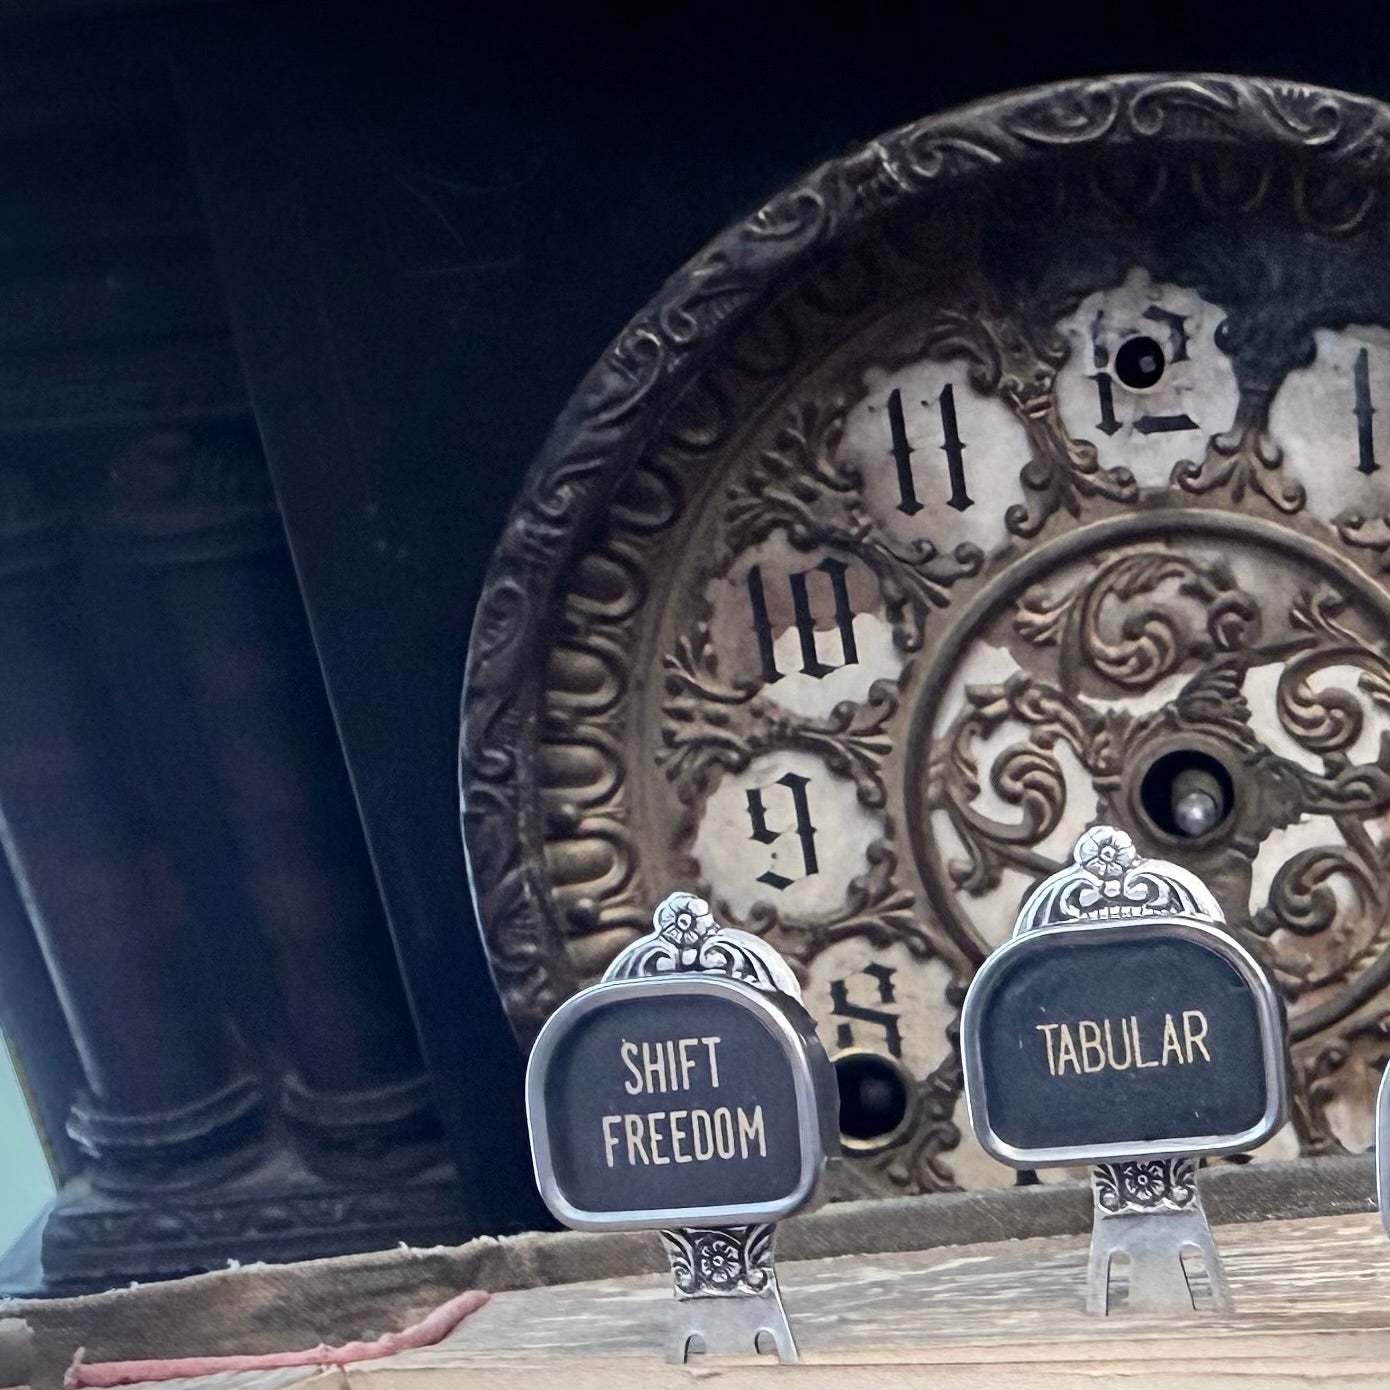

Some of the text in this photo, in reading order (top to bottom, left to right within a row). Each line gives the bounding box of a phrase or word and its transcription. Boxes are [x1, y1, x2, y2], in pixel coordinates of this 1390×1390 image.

[745, 771, 820, 891] 9
[621, 1037, 721, 1096] SHIFT
[1036, 1010, 1211, 1076] TABULAR
[602, 1105, 767, 1168] FREEDOM
